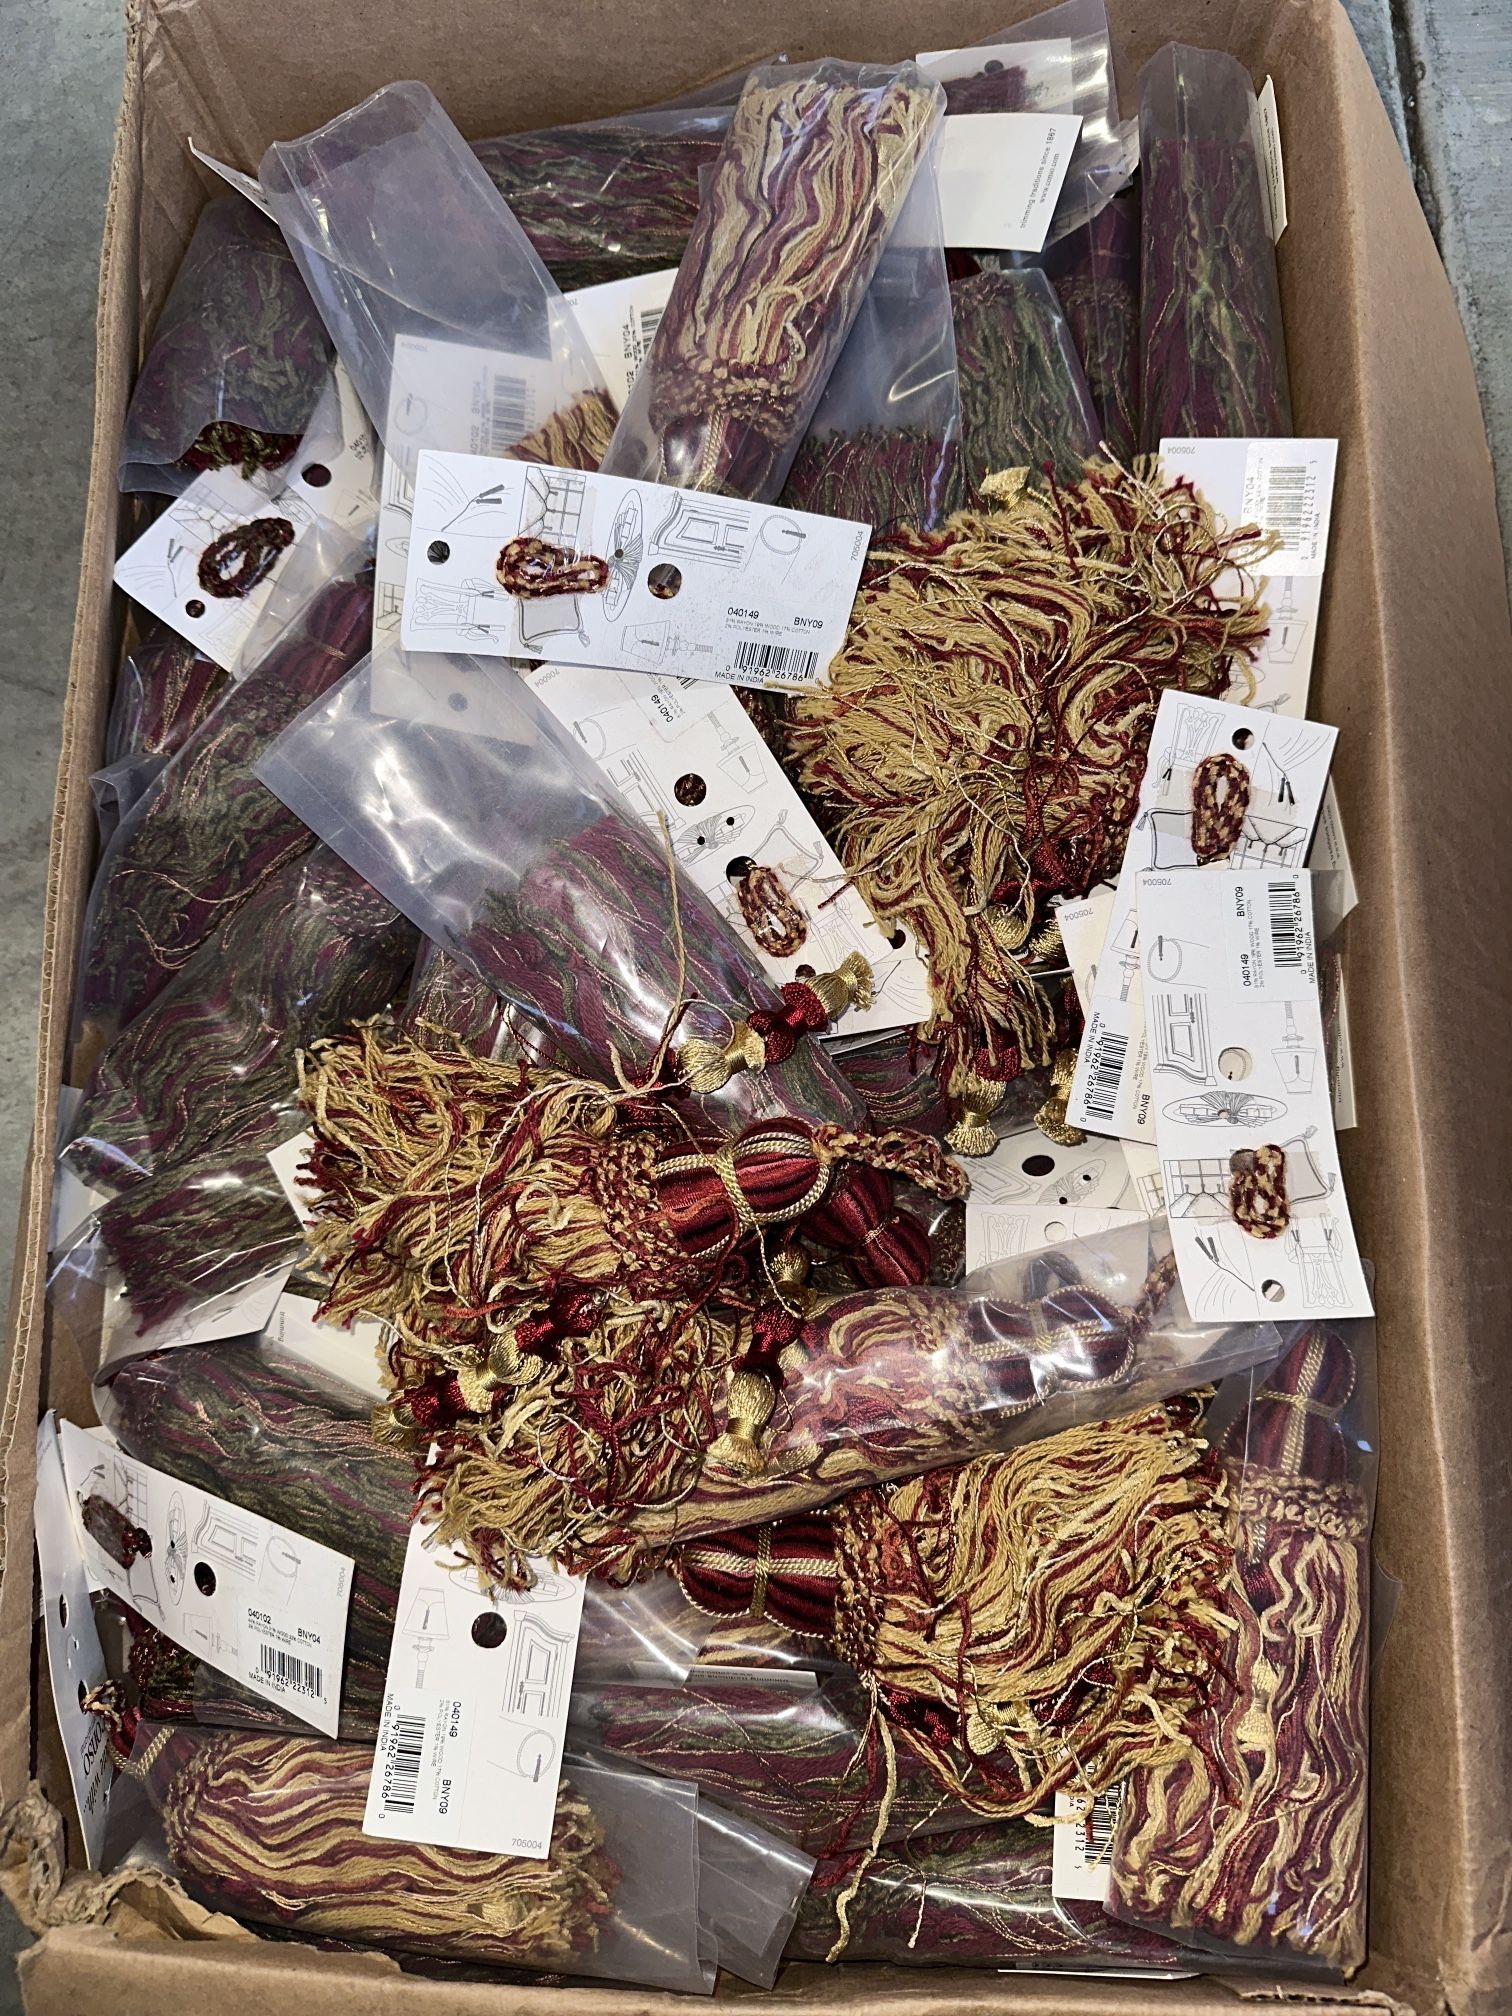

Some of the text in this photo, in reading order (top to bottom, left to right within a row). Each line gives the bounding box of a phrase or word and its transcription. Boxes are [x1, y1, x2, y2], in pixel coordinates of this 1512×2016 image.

[1029, 166, 1044, 197] traditions
[1040, 147, 1051, 165] since
[1046, 127, 1056, 144] 1867
[1167, 446, 1195, 455] 705004
[850, 530, 864, 561] 705004
[727, 607, 823, 629] 040149 BNY09
[732, 624, 761, 633] POLYESTER
[534, 668, 560, 688] 705004
[715, 671, 736, 680] MADE
[746, 675, 764, 683] INDIA
[725, 664, 731, 672] 0
[742, 665, 771, 677] 91962
[774, 670, 803, 682] 26786
[651, 694, 674, 723] 040149
[1142, 878, 1172, 886] 705004
[1064, 907, 1094, 922] 705004
[1292, 891, 1302, 922] 26786
[1234, 886, 1251, 987] 040149 BNY09
[1294, 927, 1305, 958] 91962
[1304, 931, 1315, 983] MADE IN INDIA
[1084, 1011, 1100, 1063] MADE IN INDIA
[1090, 1040, 1104, 1070] 91962
[1083, 1074, 1097, 1105] 26786
[1132, 1089, 1140, 1109] COTTON
[1137, 1094, 1150, 1125] BNY09
[248, 1608, 321, 1644] 040102 BNY04
[248, 1671, 285, 1693] MADE IN INDIA
[266, 1670, 289, 1687] 91962
[292, 1681, 316, 1699] 22312
[380, 1693, 394, 1751] MADE IN INDIA
[435, 1709, 444, 1741] POLYESTER
[387, 1724, 400, 1758] 91962
[438, 1701, 462, 1814] 040149 BNY09
[381, 1764, 394, 1799] 26786
[432, 1777, 440, 1800] COTTON
[512, 1838, 542, 1849] 705004
